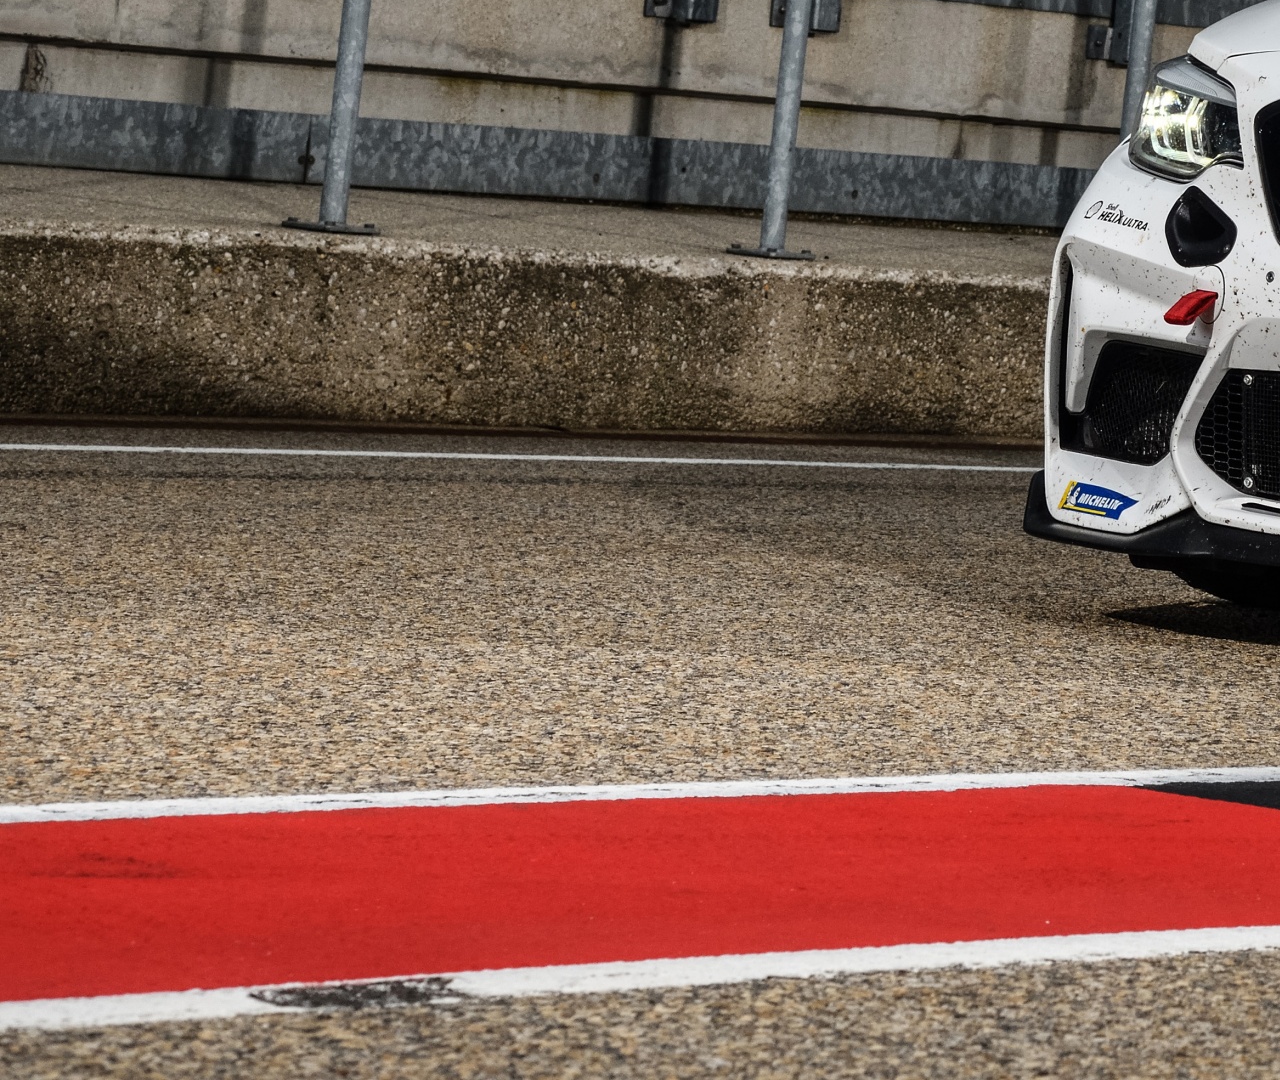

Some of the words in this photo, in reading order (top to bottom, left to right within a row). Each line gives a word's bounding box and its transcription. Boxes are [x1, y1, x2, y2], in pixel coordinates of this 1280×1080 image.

[1098, 210, 1124, 224] HELIX
[1122, 217, 1148, 231] ULTRA
[1077, 492, 1123, 510] MICHELIN
